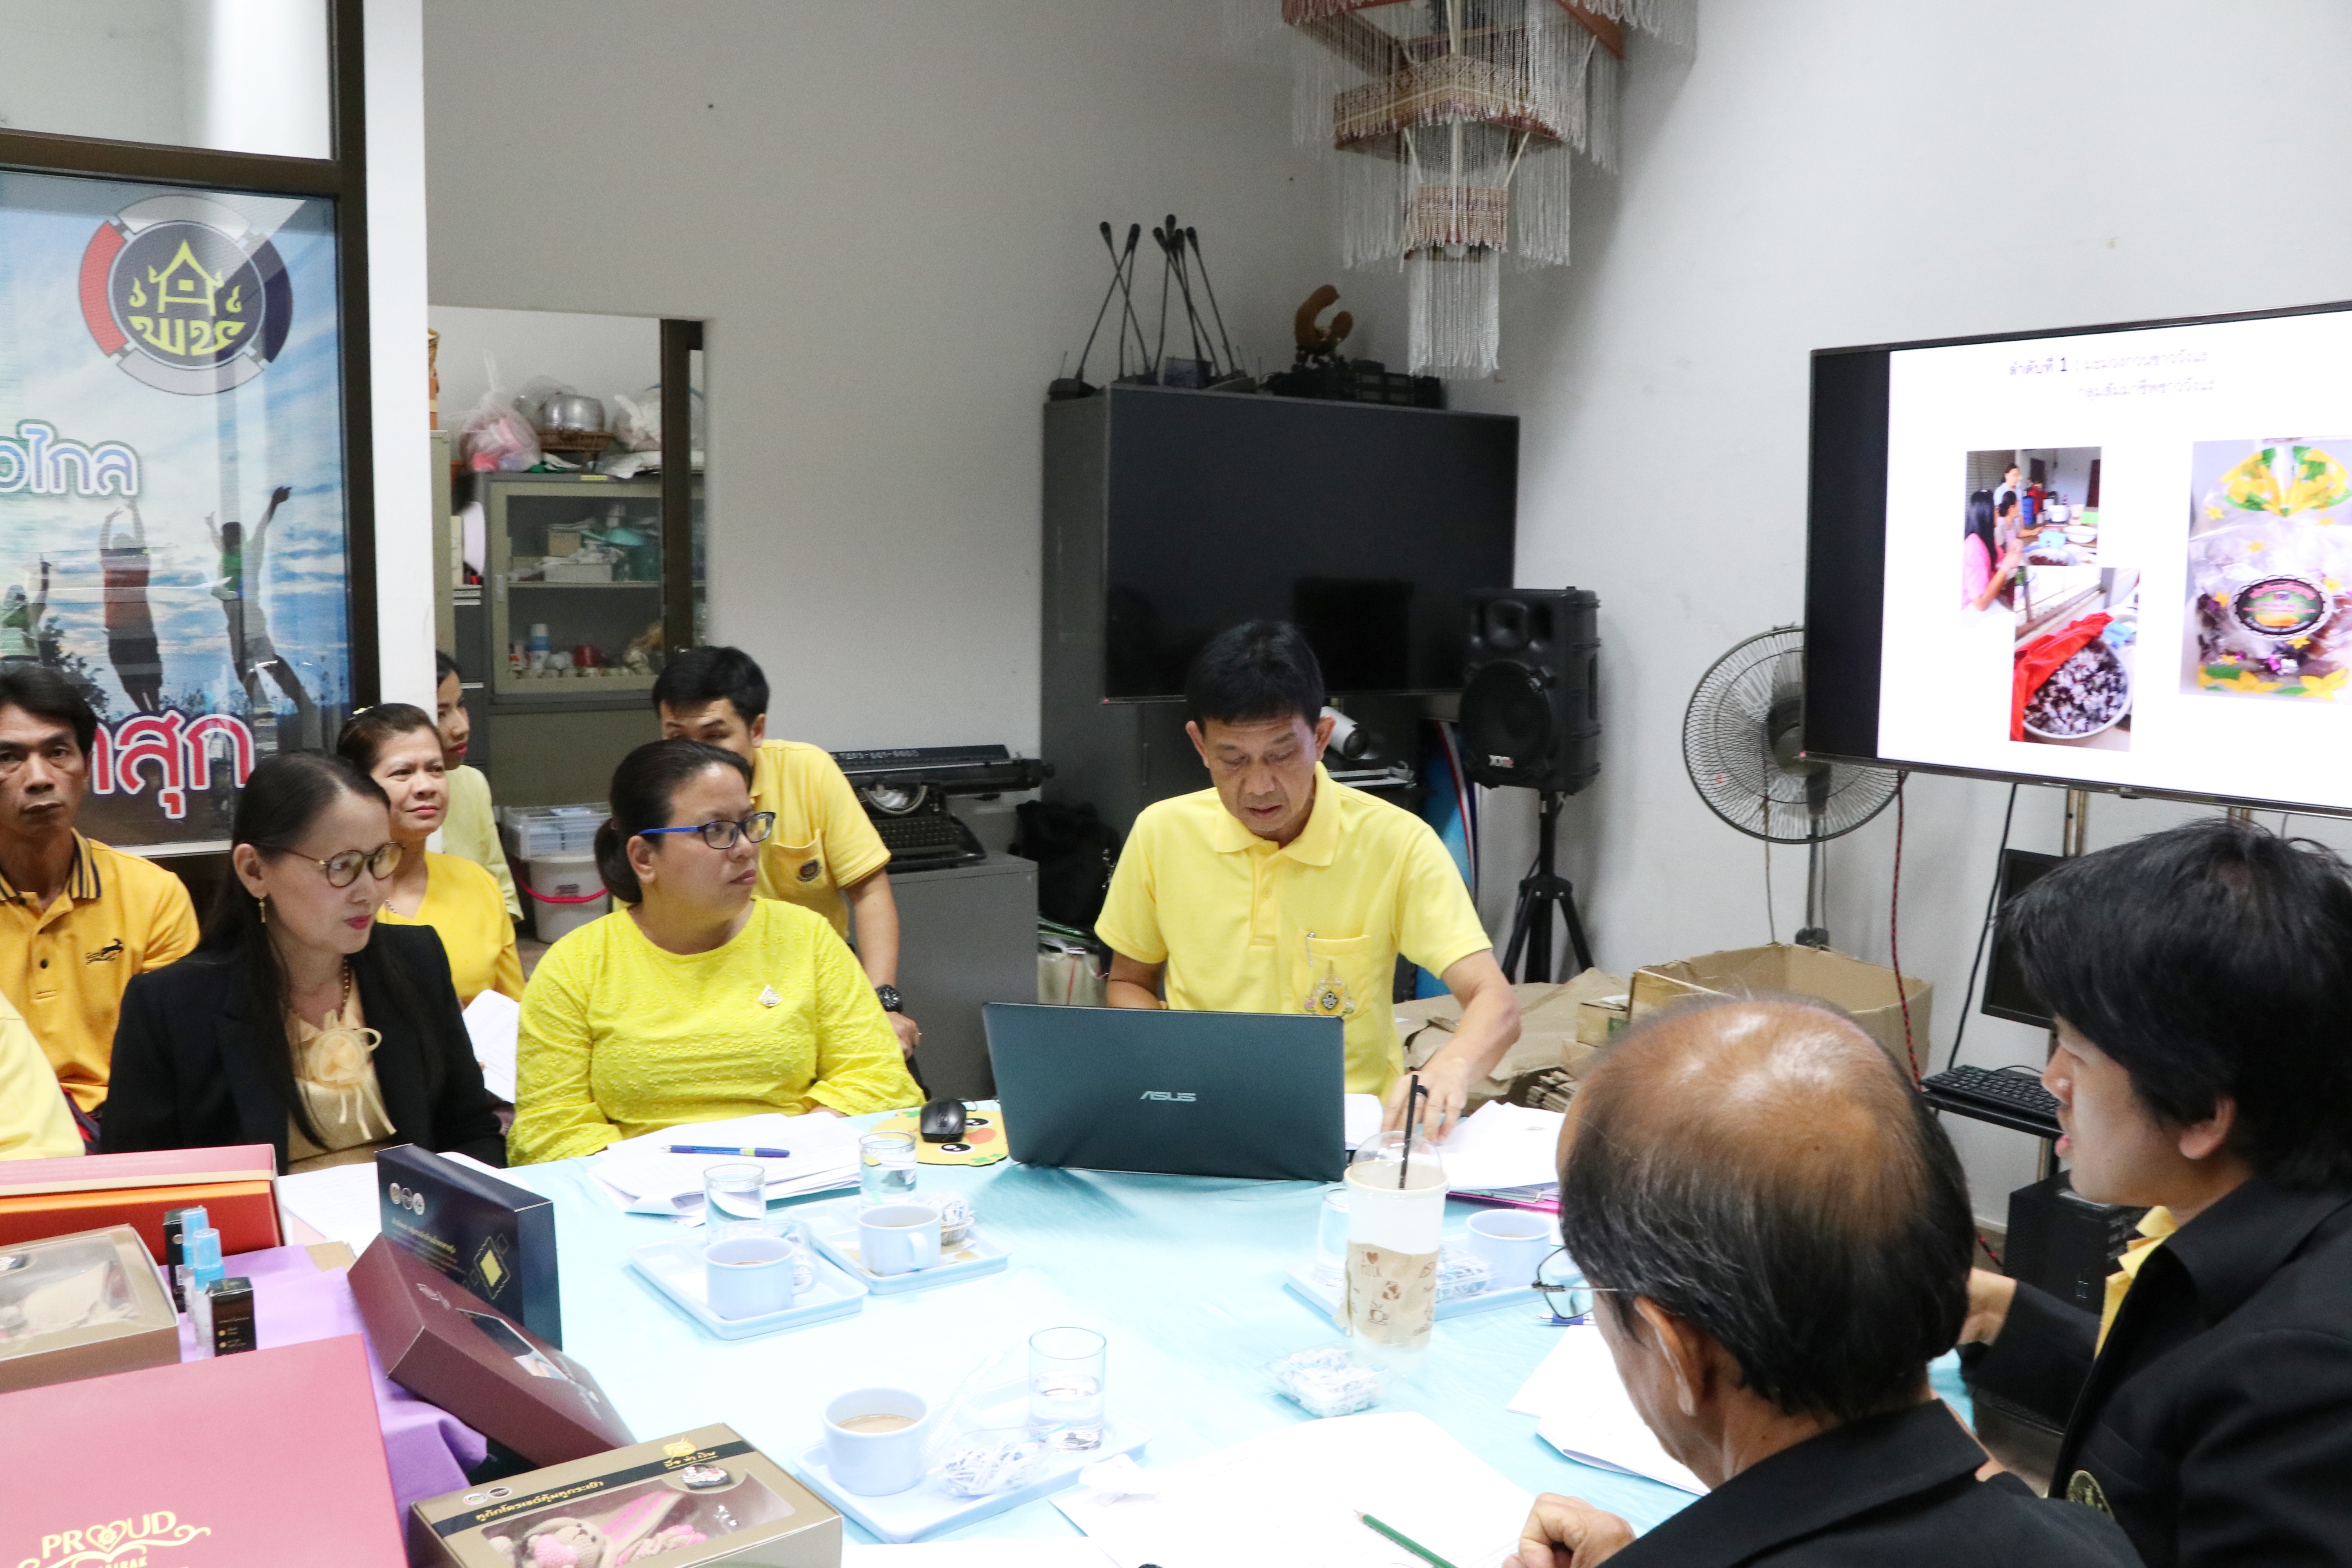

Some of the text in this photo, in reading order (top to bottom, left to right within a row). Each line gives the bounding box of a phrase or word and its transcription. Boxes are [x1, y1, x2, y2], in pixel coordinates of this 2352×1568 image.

[2008, 354, 2054, 376] ลำดับที่
[2058, 356, 2069, 372] 1
[91, 709, 256, 820] าสุก
[1141, 1091, 1197, 1102] ASUS
